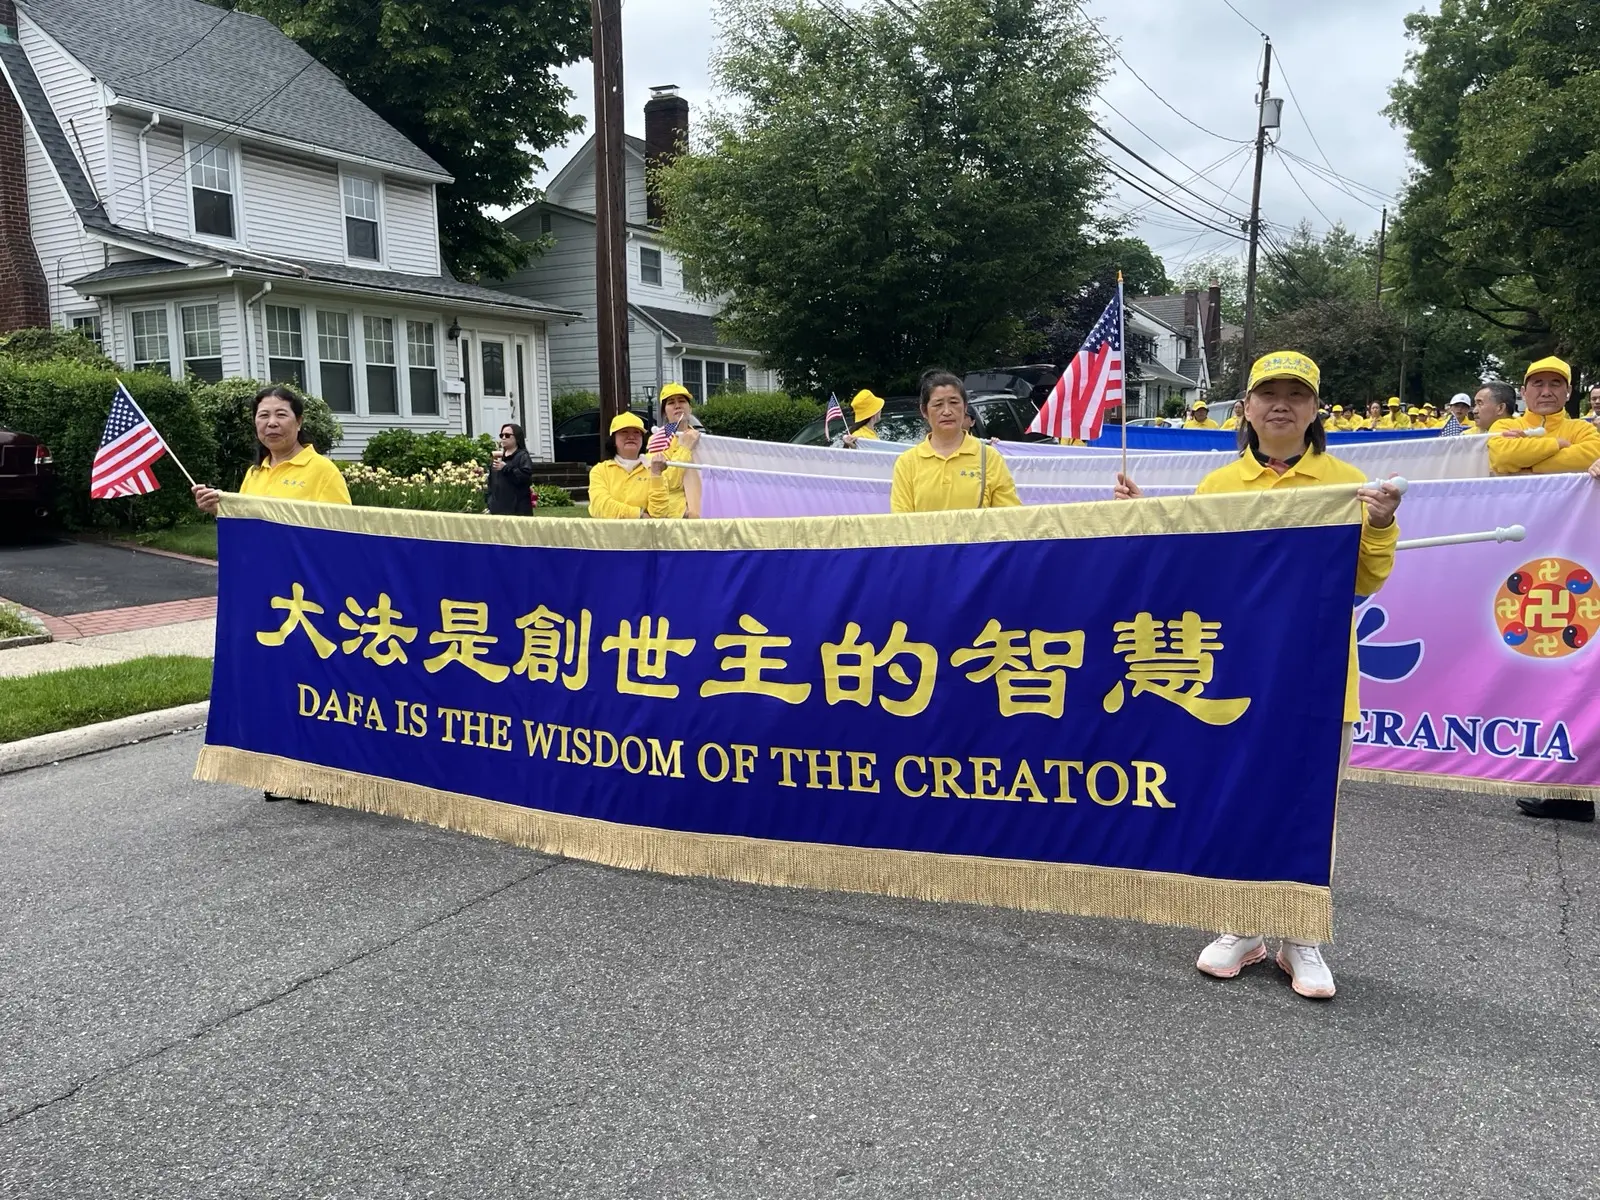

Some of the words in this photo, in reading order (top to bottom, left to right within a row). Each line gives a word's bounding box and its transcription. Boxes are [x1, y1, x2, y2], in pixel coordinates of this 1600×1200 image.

[255, 582, 1251, 726] 大法是創世主的智慧
[297, 683, 388, 734] DAFA
[395, 699, 428, 739] IS
[438, 707, 513, 754] THE
[523, 719, 684, 779] WISDOM
[697, 742, 759, 786] OF
[771, 748, 881, 795] THE
[894, 755, 1177, 809] CREATOR
